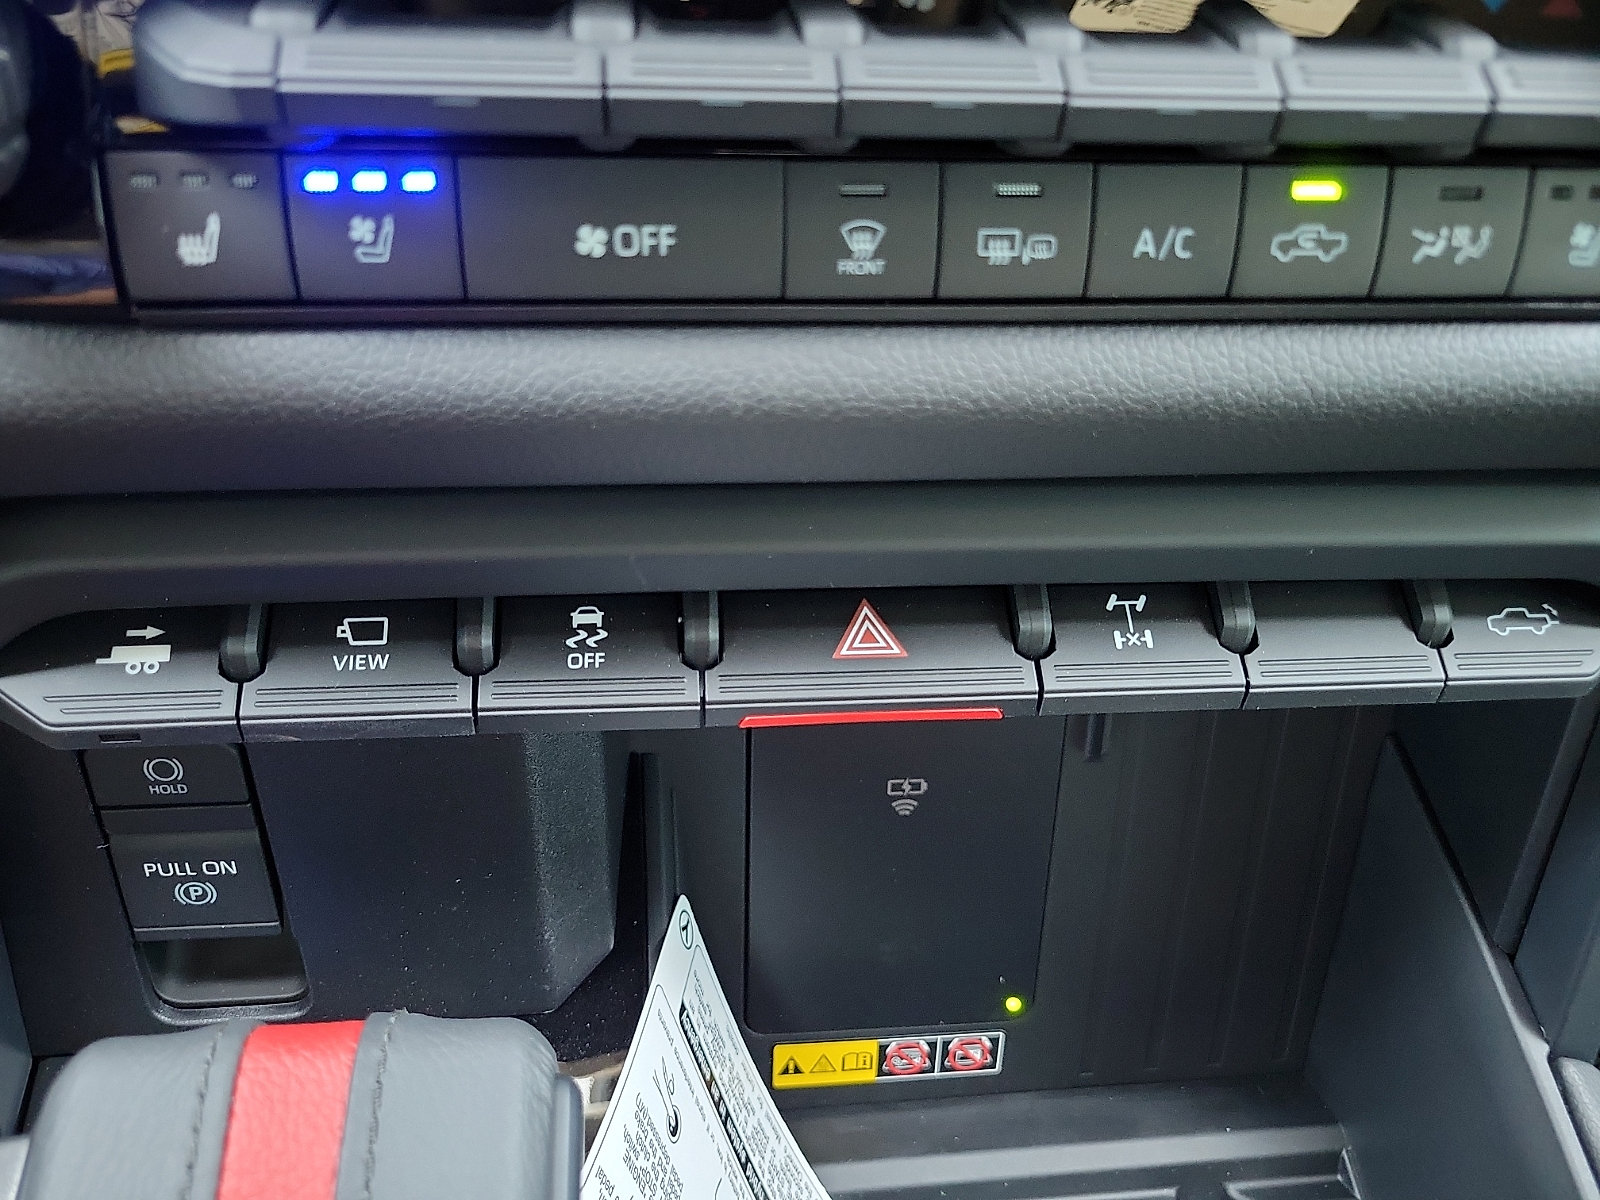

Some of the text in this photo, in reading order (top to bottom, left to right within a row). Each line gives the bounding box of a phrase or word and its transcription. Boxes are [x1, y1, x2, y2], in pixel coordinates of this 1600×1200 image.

[612, 223, 677, 257] OFF
[1132, 225, 1195, 261] A/C
[836, 259, 886, 275] FRONT
[332, 653, 389, 671] VIEW
[566, 652, 606, 669] OFF
[149, 784, 188, 795] HOLD
[143, 860, 237, 877] PULL ON
[188, 885, 203, 901] P
